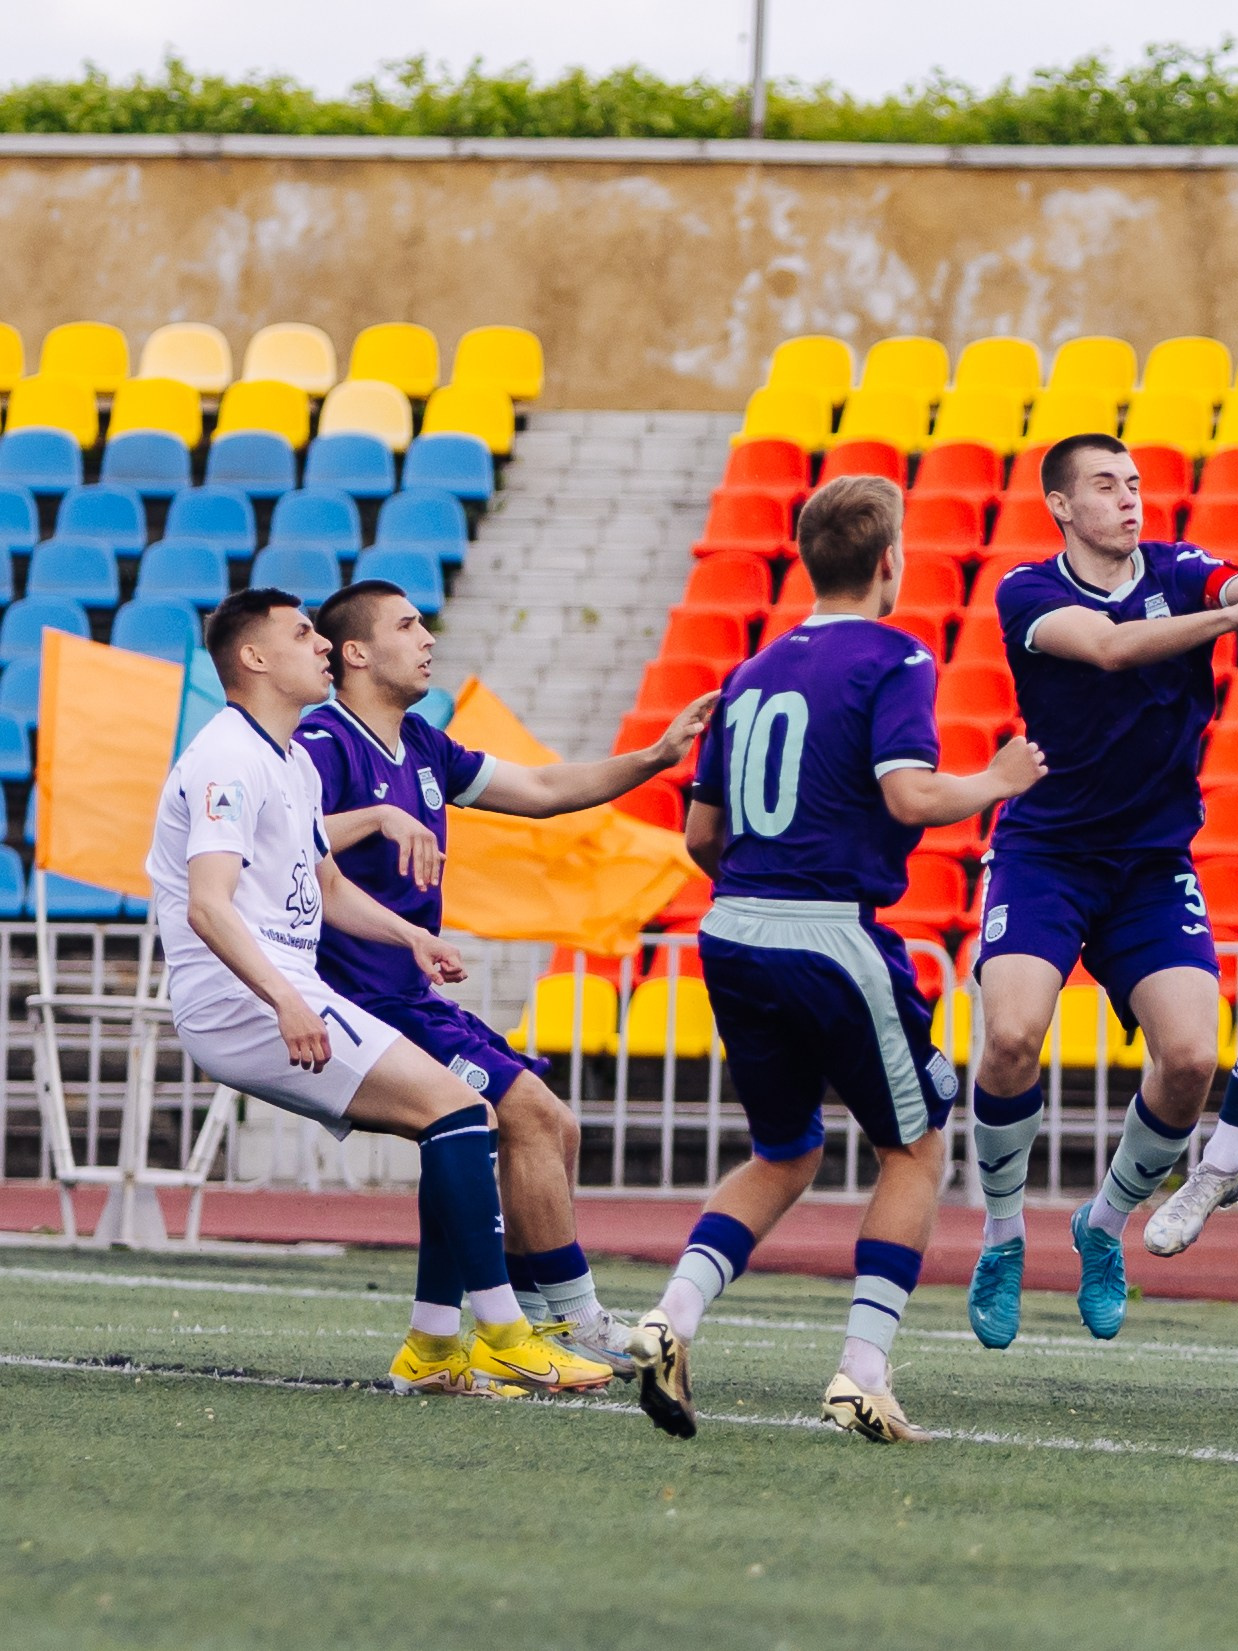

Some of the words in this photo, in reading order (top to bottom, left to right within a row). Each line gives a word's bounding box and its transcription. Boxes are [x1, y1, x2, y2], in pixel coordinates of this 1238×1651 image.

[726, 688, 809, 837] 10
[1174, 873, 1207, 916] 3
[320, 1005, 363, 1047] 7
